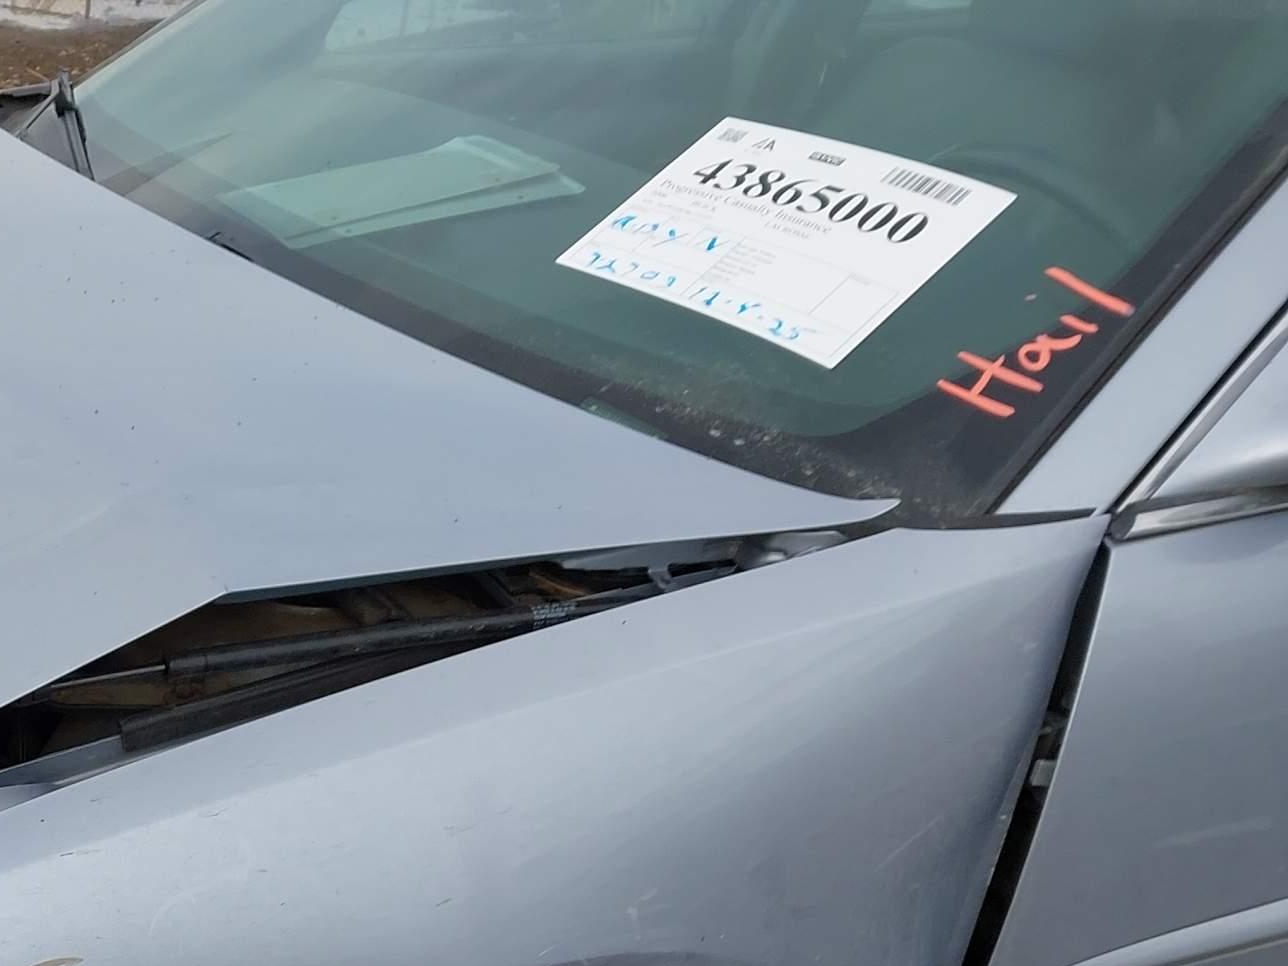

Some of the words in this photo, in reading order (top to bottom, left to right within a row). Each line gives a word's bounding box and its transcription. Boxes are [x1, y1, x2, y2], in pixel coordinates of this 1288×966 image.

[692, 158, 930, 245] 43865000
[775, 207, 832, 235] Insurance
[936, 266, 1135, 418] Hail
